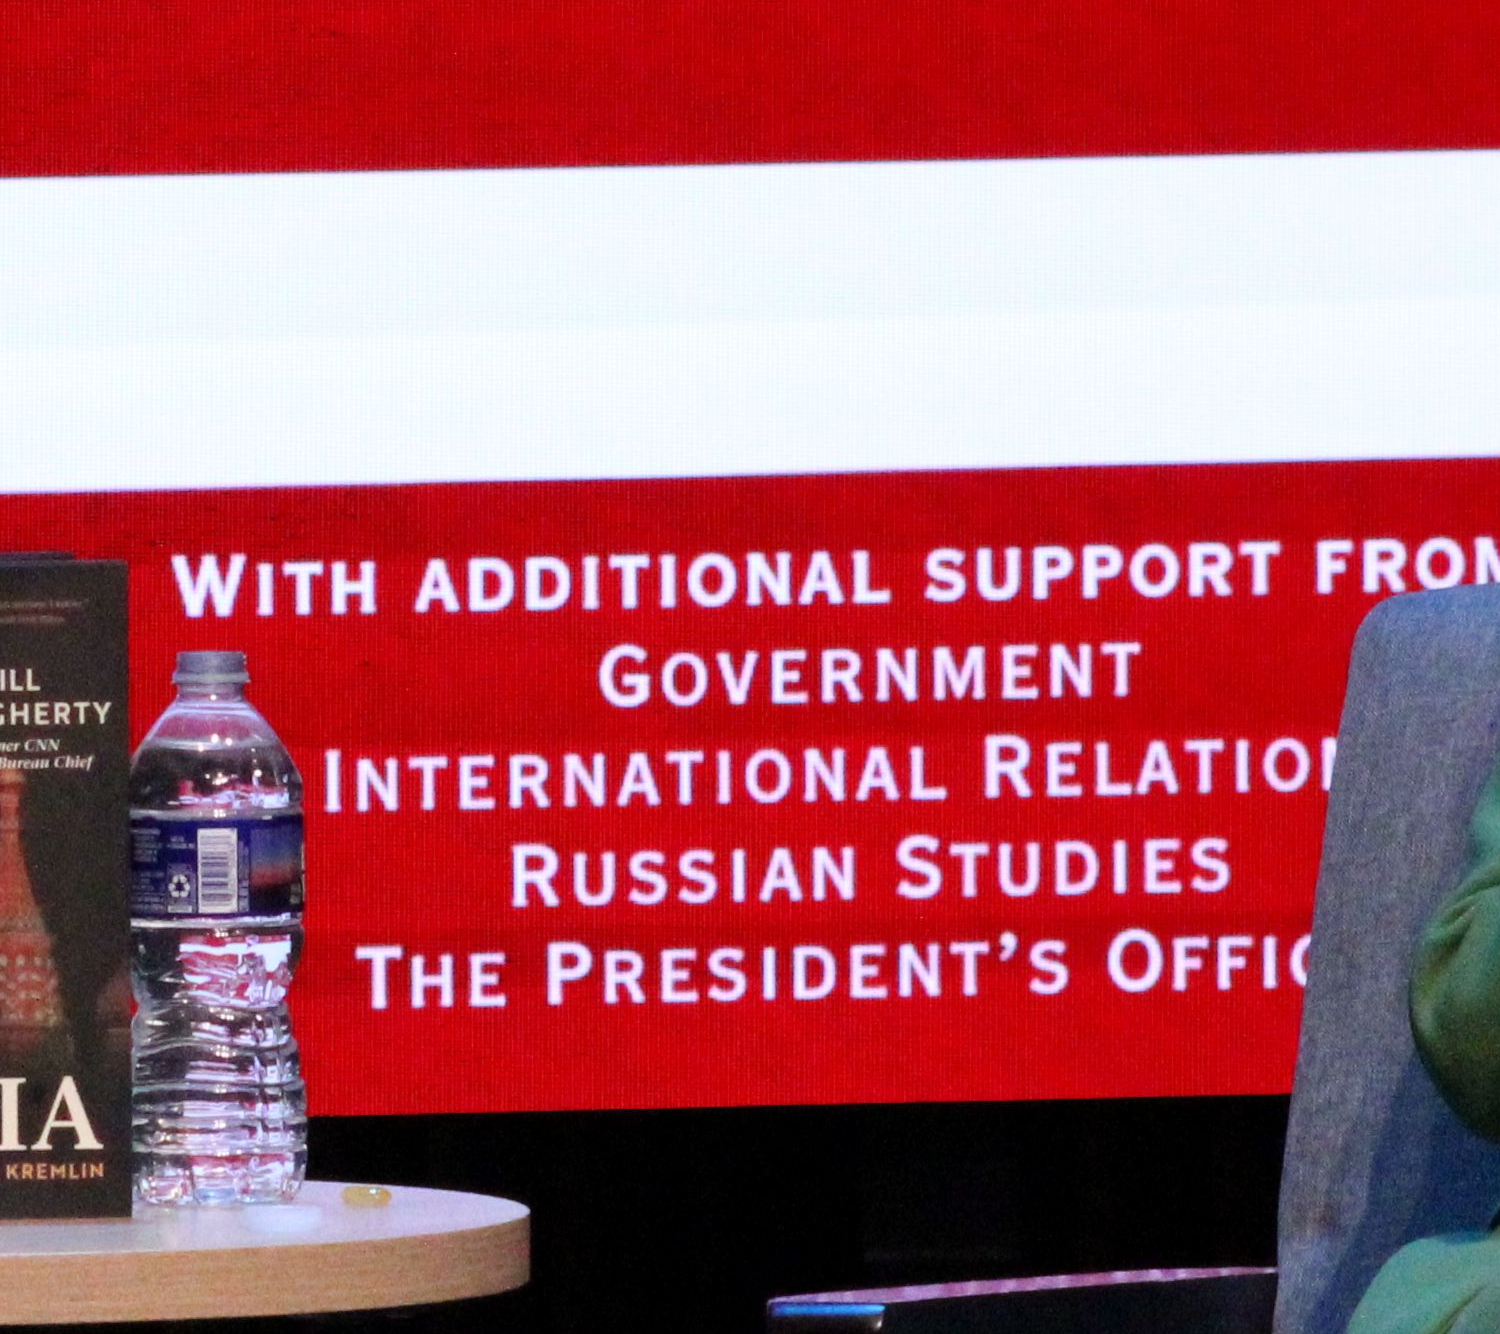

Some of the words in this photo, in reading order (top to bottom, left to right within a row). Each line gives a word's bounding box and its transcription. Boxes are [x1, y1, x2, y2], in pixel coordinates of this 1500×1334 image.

[172, 553, 376, 617] WITH
[415, 550, 891, 612] ADDITIONAL
[925, 541, 1280, 602] SUPPORT
[599, 642, 1141, 707] GOVERNMENT
[24, 738, 61, 753] CNN
[53, 755, 95, 771] Chief
[326, 747, 947, 812] INTERNATIONAL
[513, 843, 854, 907] RUSSIAN
[897, 835, 1229, 899] STUDIES
[356, 946, 506, 1009] THE
[6, 1162, 104, 1179] KREMLIN
